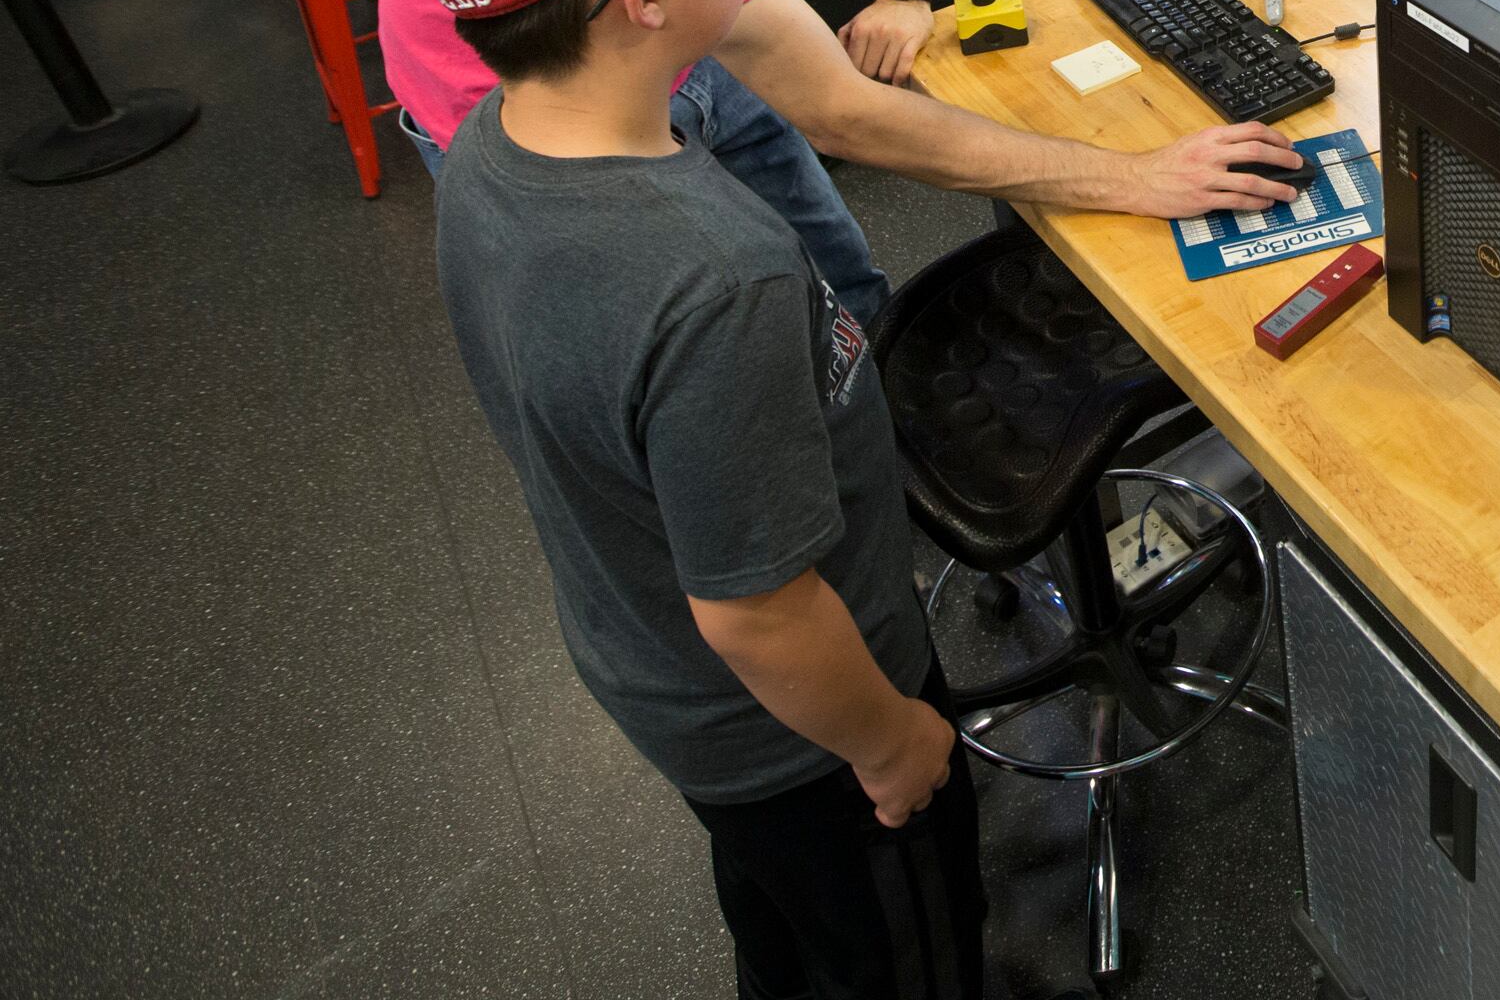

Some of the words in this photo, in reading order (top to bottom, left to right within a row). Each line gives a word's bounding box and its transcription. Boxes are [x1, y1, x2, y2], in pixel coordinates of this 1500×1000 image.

[1262, 33, 1281, 48] DELL
[1242, 224, 1354, 258] ShopBot
[1480, 250, 1500, 271] DELL
